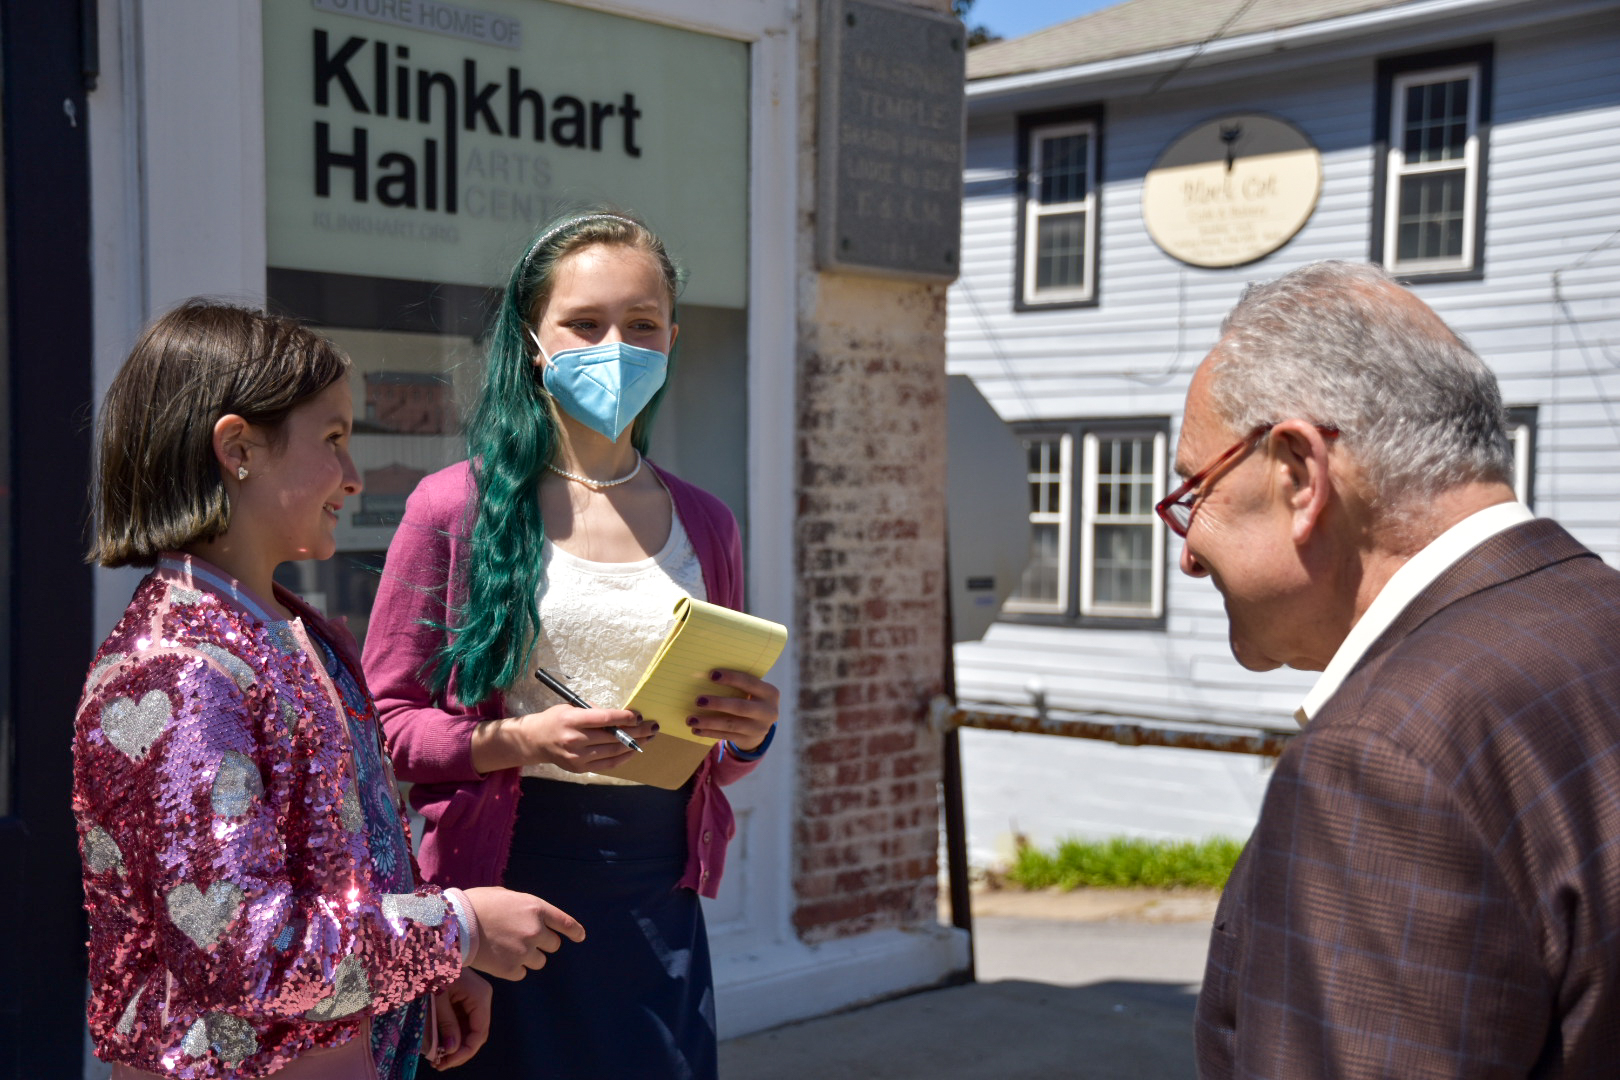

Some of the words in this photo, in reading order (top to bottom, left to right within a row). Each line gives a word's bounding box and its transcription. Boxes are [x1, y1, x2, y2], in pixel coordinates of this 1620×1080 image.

[316, 0, 412, 23] TURE
[419, 4, 486, 38] HOME
[490, 18, 521, 43] OF
[313, 28, 643, 158] Klinkhart
[314, 121, 458, 215] Hall
[465, 146, 552, 190] ARTS
[464, 184, 556, 224] CENT
